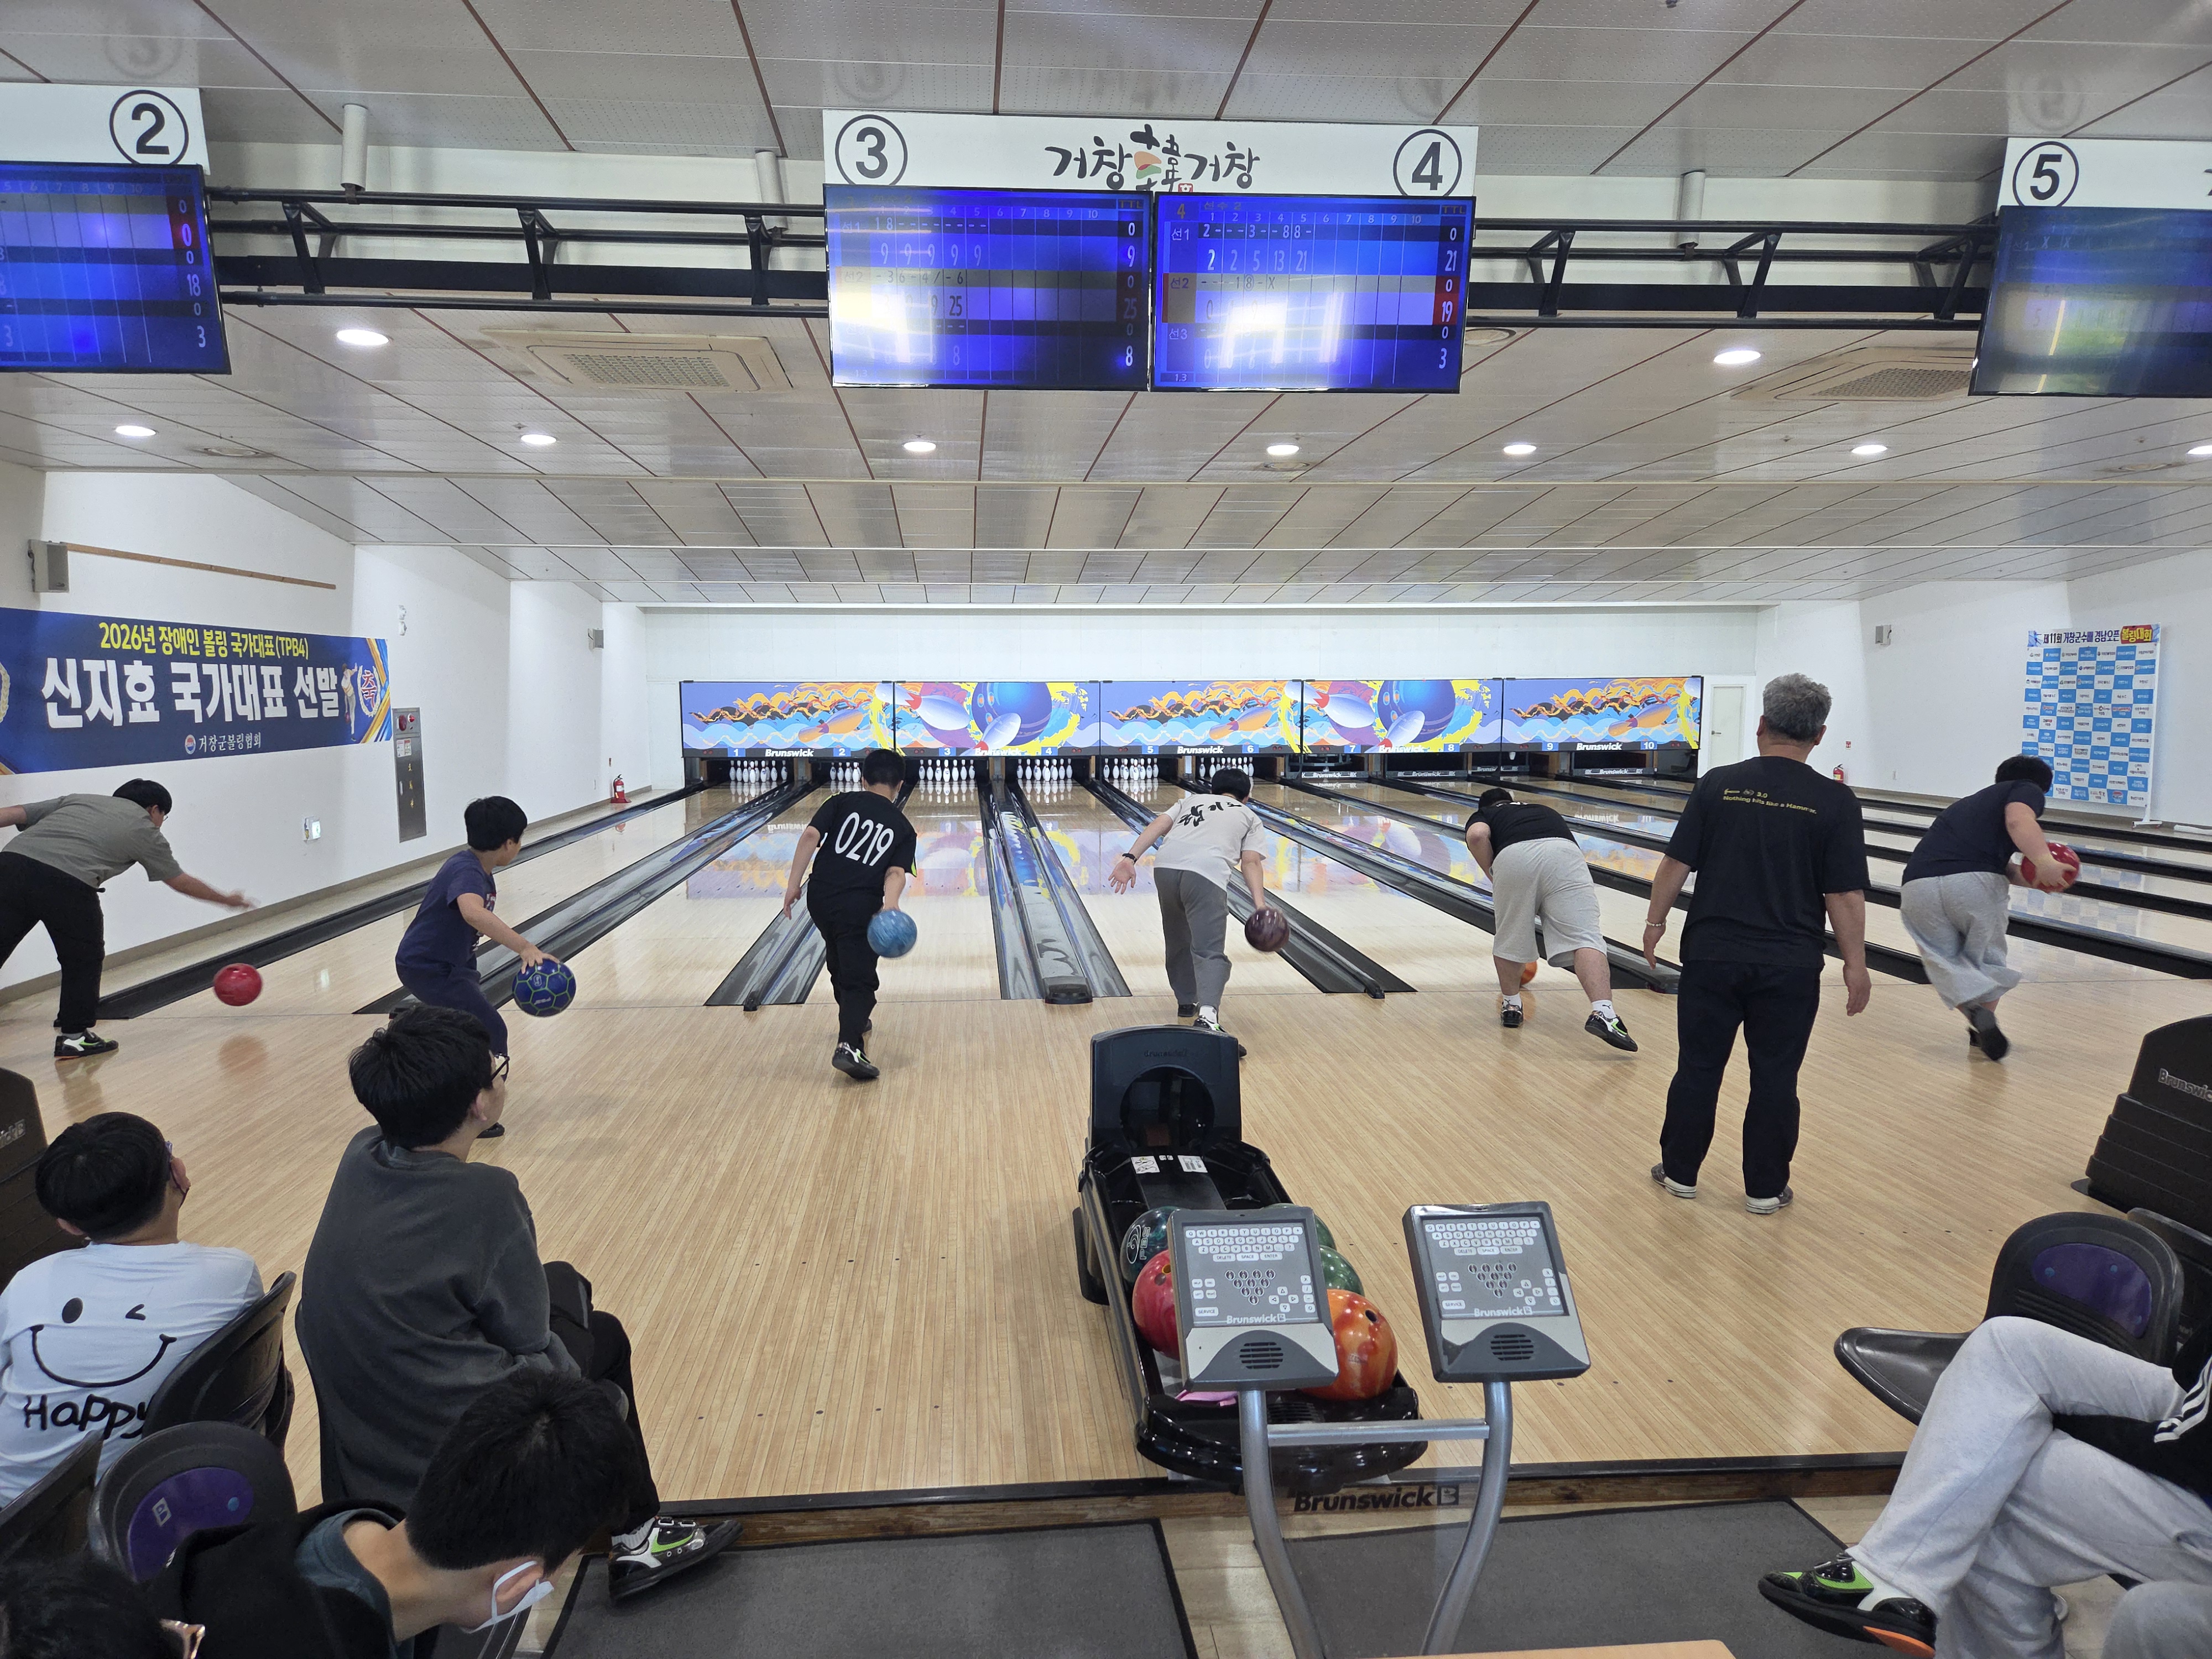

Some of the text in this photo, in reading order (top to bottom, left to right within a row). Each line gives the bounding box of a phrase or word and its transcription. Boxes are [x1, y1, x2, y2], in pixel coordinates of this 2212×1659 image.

[132, 103, 170, 155] 2
[855, 127, 888, 179] 3
[1411, 142, 1443, 191] 4
[2030, 154, 2062, 200] 5
[179, 200, 187, 213] 0
[950, 207, 957, 215] 4
[974, 207, 980, 216] 5
[997, 208, 1003, 216] 6
[1020, 208, 1026, 217] 7
[1044, 210, 1050, 218] 8
[1067, 210, 1073, 218] 9
[1088, 210, 1098, 218] 10
[1119, 200, 1142, 208] TTL
[1177, 204, 1185, 219] 4
[1211, 212, 1214, 221] 1
[1233, 213, 1239, 221] 2
[1301, 214, 1307, 222] 5
[1323, 215, 1329, 223] 6
[1345, 215, 1352, 223] 7
[1368, 215, 1375, 223] 8
[1391, 215, 1397, 223] 9
[1411, 215, 1421, 224] 10
[182, 224, 191, 246] 0
[1128, 222, 1135, 236] 0
[1171, 228, 1189, 241] 선1
[1449, 228, 1457, 241] 0
[186, 251, 194, 264] 0
[1127, 246, 1135, 267] 9
[1208, 249, 1457, 272] 2 2 5 13 21 21
[187, 274, 201, 296] 18
[1127, 275, 1134, 288] 0
[1446, 279, 1453, 292] 0
[194, 302, 201, 316] 0
[949, 295, 1137, 319] 25 25
[1442, 301, 1453, 322] 19
[197, 326, 206, 347] 3
[1127, 323, 1133, 336] 0
[1169, 326, 1449, 340] 선3 0
[1125, 346, 1133, 366] 8
[1438, 348, 1447, 369] 3
[99, 622, 309, 660] 2026년 장애인 볼링 국가대표(TPB4)
[2043, 633, 2062, 644] 제11회
[41, 658, 340, 728] 신지효 국가대표 선발
[362, 669, 377, 708] 축
[199, 732, 261, 753] 거창군볼링협회
[765, 749, 814, 757] Brunswick
[1577, 743, 1623, 751] Brunswick
[835, 812, 894, 867] 0219
[1140, 1227, 1151, 1260] PBS
[1227, 1314, 1277, 1324] Brunswick
[1474, 1307, 1523, 1317] Brunswick
[24, 1394, 147, 1439] Happy
[1294, 1486, 1436, 1512] Brunswick
